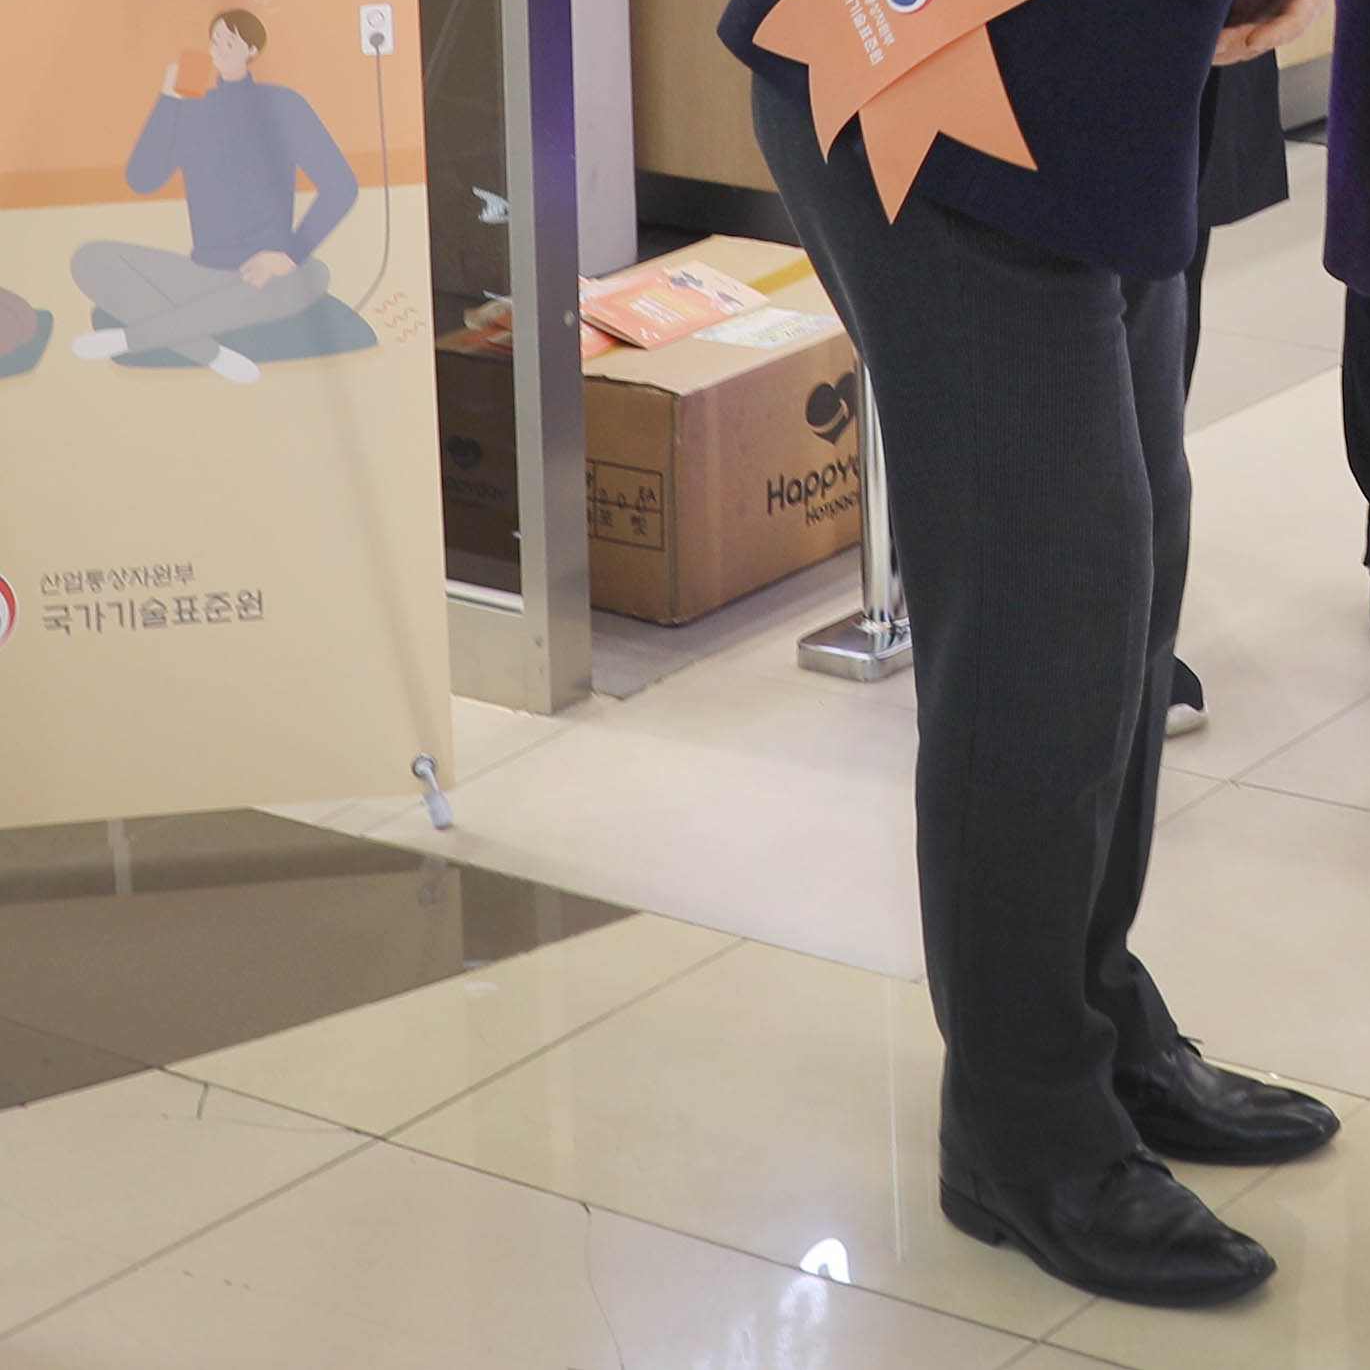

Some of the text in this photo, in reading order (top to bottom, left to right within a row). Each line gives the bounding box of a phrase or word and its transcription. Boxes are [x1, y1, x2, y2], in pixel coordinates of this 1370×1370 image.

[767, 453, 861, 517] Happy
[40, 562, 196, 596] 산업통상자원부
[42, 589, 266, 636] 국가기술표준원
